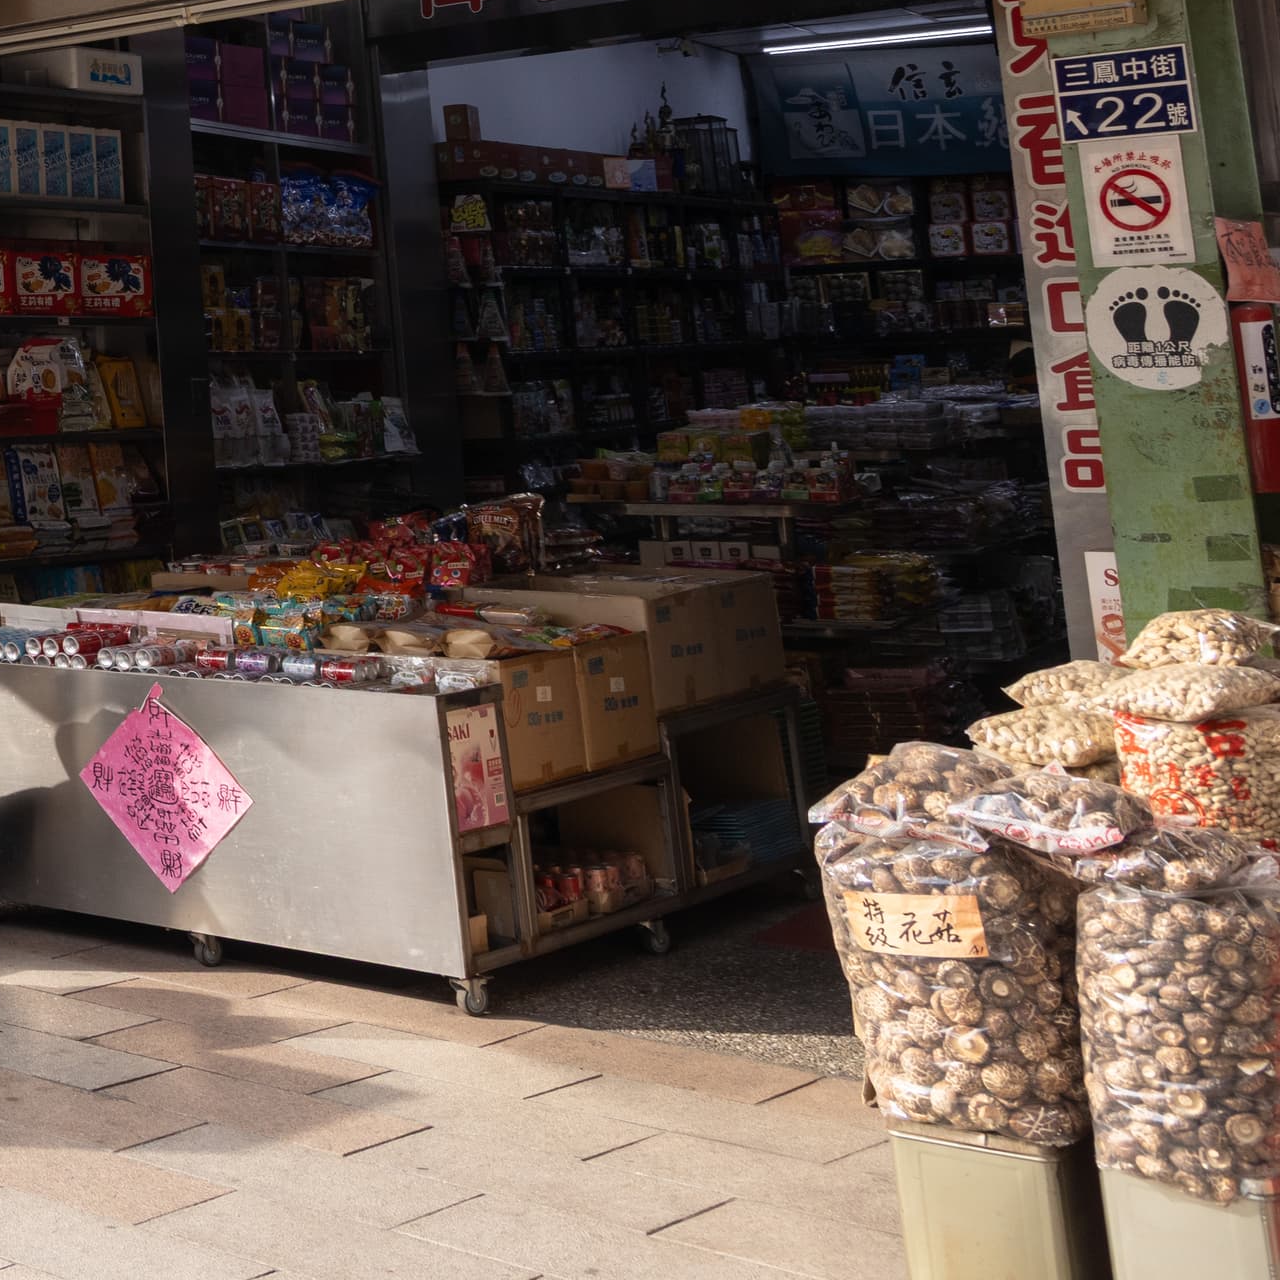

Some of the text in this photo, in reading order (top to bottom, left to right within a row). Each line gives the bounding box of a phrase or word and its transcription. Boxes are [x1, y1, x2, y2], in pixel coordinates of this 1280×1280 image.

[1063, 53, 1177, 87] 三鳳中街
[1094, 91, 1189, 133] 22號
[1093, 151, 1172, 175] 本場所禁止吸菸
[1111, 354, 1210, 369] 病毒傳播能防
[863, 898, 900, 950] 特級
[899, 909, 963, 945] 花菇
